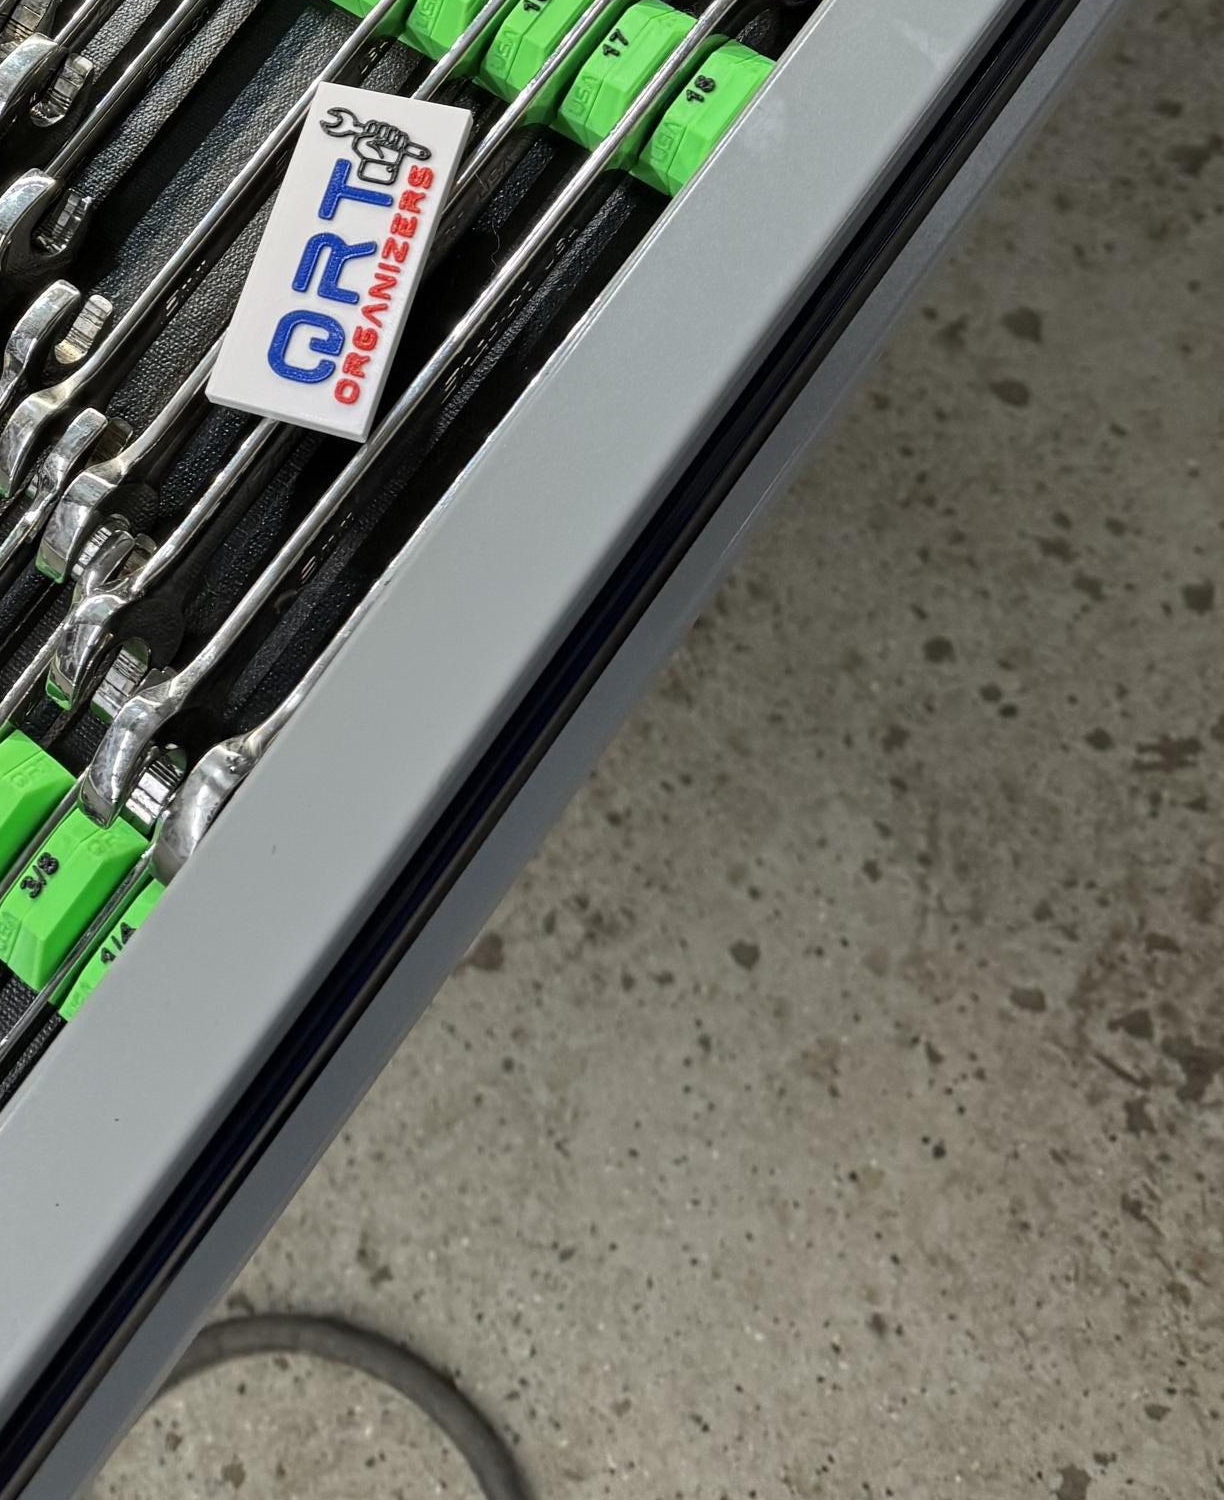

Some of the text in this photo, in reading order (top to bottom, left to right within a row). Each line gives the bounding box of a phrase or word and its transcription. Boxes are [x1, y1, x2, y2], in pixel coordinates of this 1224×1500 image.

[602, 28, 630, 59] 17
[686, 73, 716, 105] 18
[267, 157, 395, 384] QRT
[333, 163, 435, 406] ORGANIZERS
[18, 851, 61, 900] 3/8
